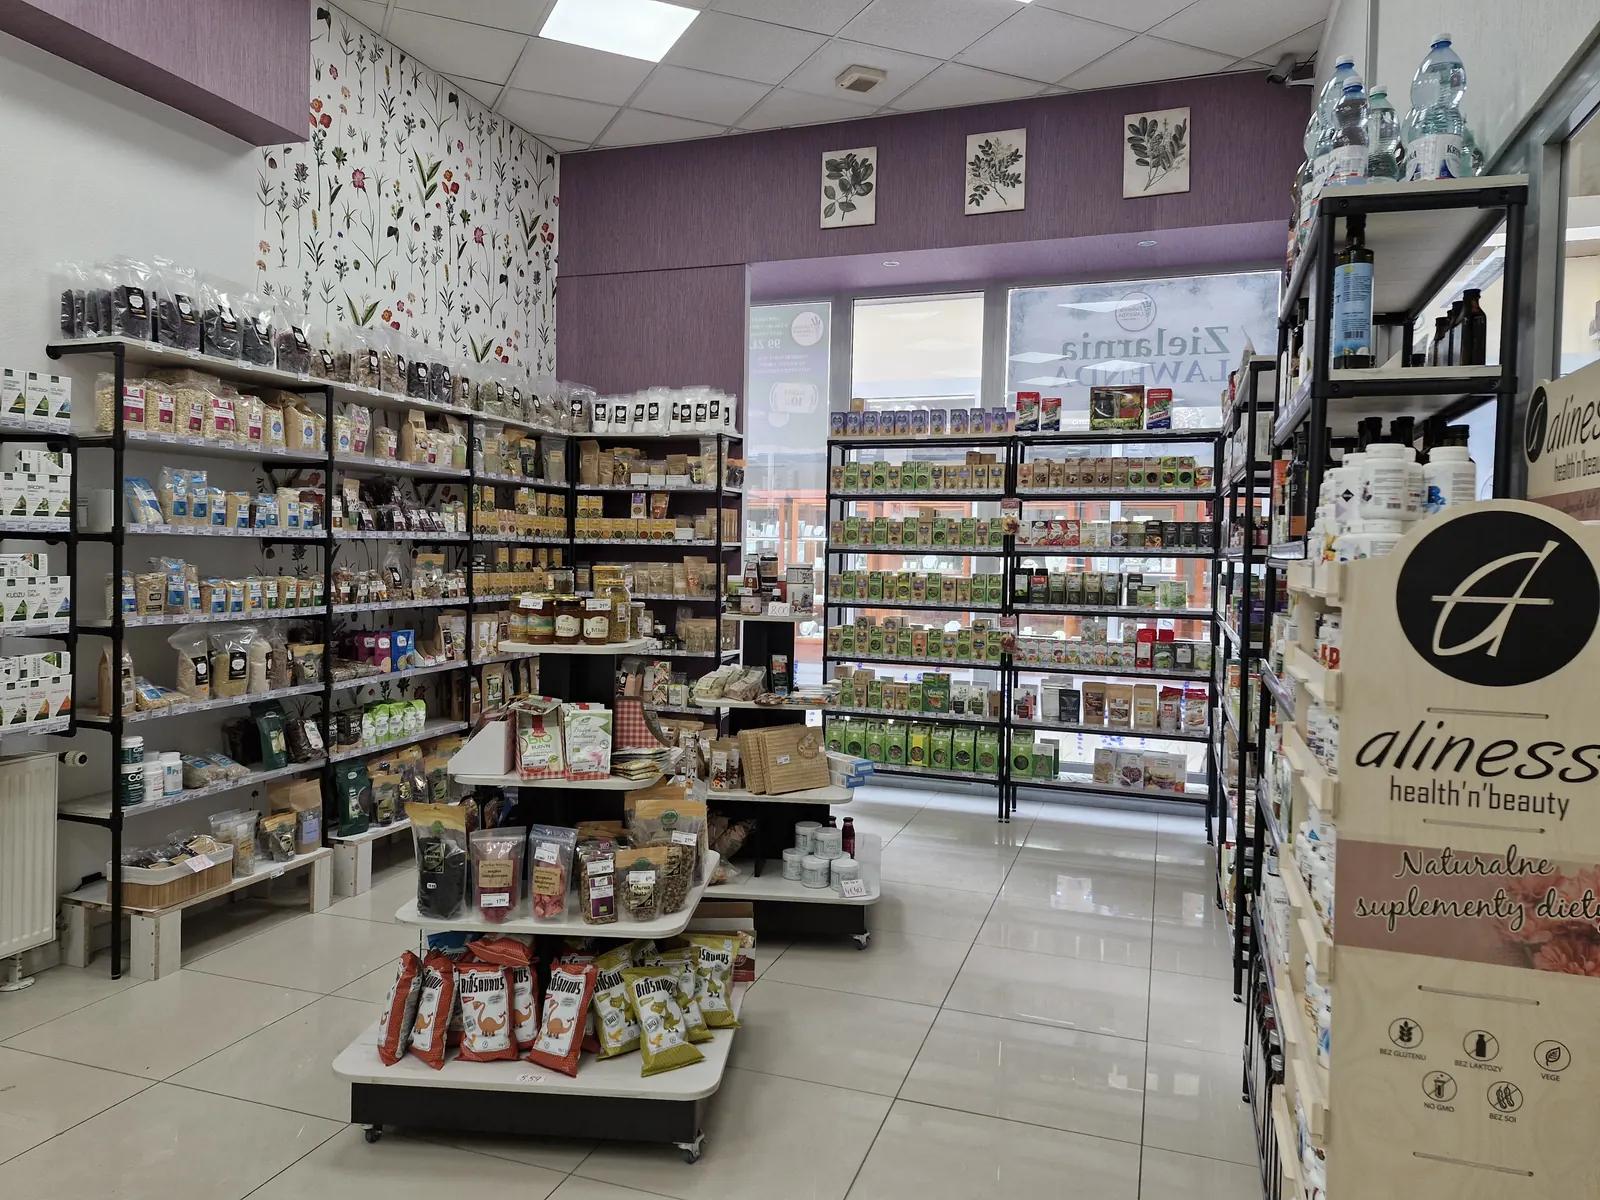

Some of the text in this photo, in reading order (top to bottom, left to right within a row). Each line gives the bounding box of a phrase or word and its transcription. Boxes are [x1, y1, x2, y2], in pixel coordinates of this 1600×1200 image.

[1355, 720, 1600, 783] aliness
[1390, 775, 1570, 821] health'n'beauty
[1394, 844, 1554, 878] Naturalne
[1356, 886, 1525, 932] suplementy
[698, 948, 729, 964] SAURUS
[461, 974, 505, 994] BIOSAURUS
[593, 970, 625, 994] BIOSAUR
[1380, 1047, 1427, 1061] BEZ GLUTENU
[1454, 1059, 1503, 1073] BEZ LAKTOZY
[1540, 1072, 1560, 1082] VEGE
[1423, 1102, 1455, 1113] NO GMO
[1489, 1112, 1517, 1123] BEZ SOI
